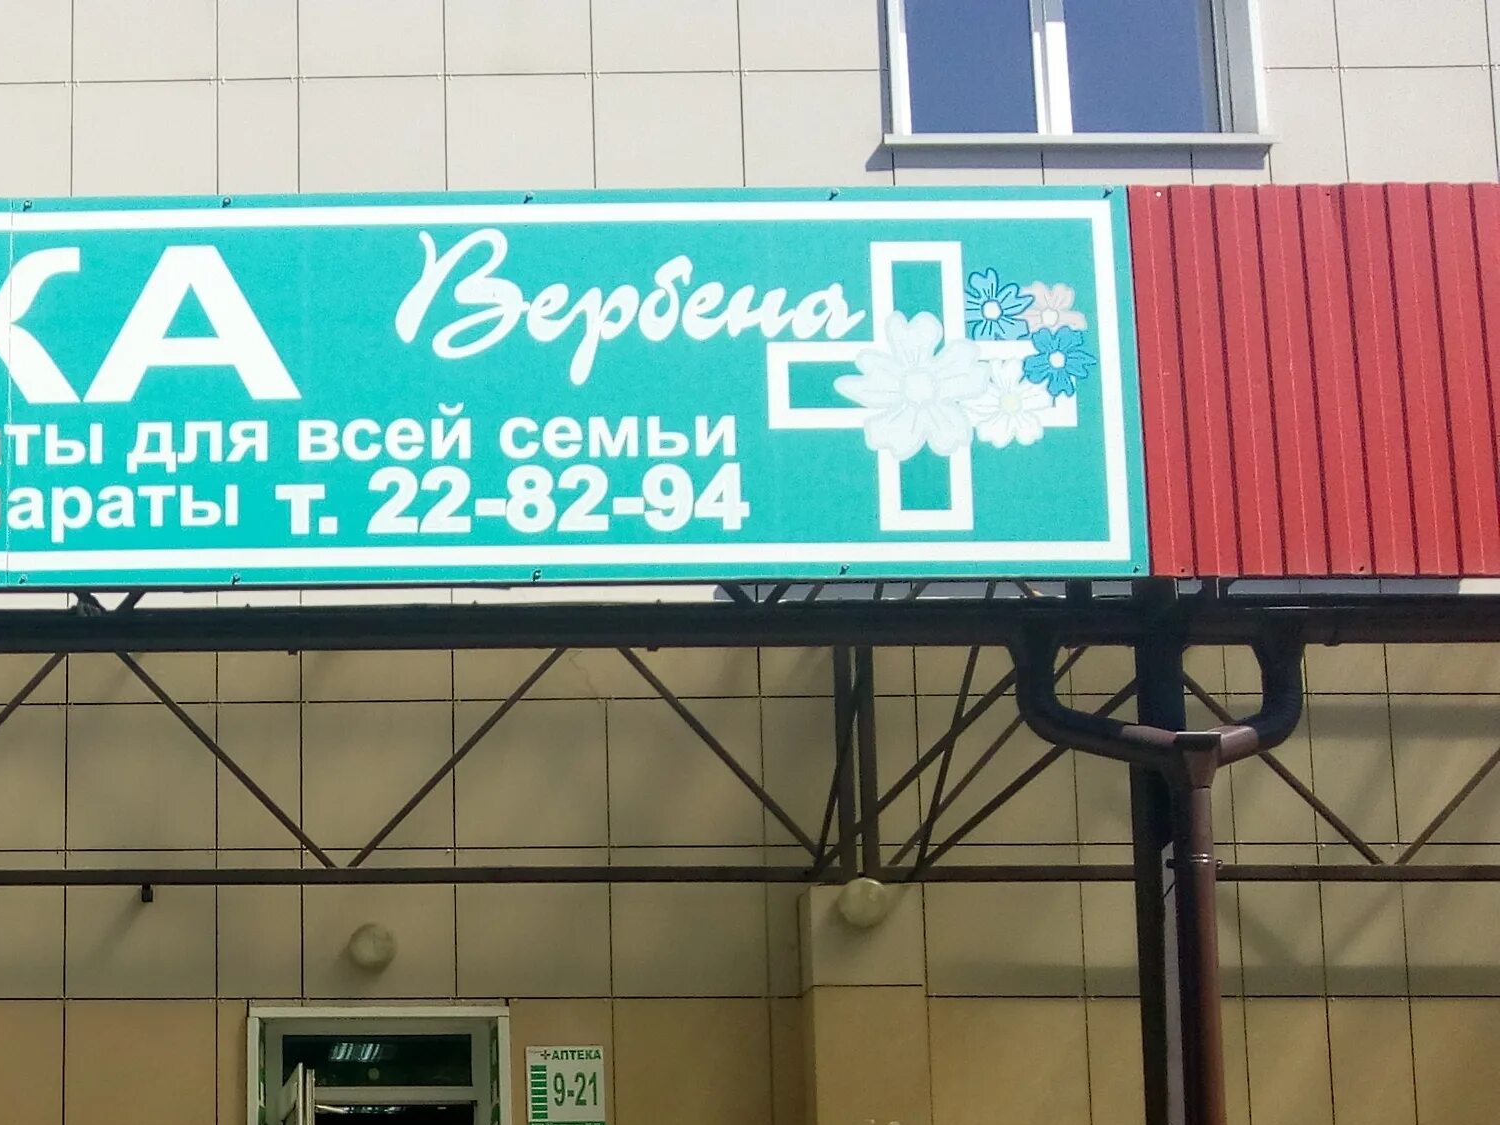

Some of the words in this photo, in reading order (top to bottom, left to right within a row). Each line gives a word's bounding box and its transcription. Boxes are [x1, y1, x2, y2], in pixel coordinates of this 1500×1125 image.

[395, 228, 866, 386] Вербена
[126, 420, 268, 473] для
[298, 403, 472, 463] всей
[499, 414, 738, 458] семьи
[275, 484, 338, 535] т.
[366, 462, 750, 535] 22-82-94
[551, 1049, 601, 1060] АПТЕКА
[553, 1072, 597, 1106] 9-21
